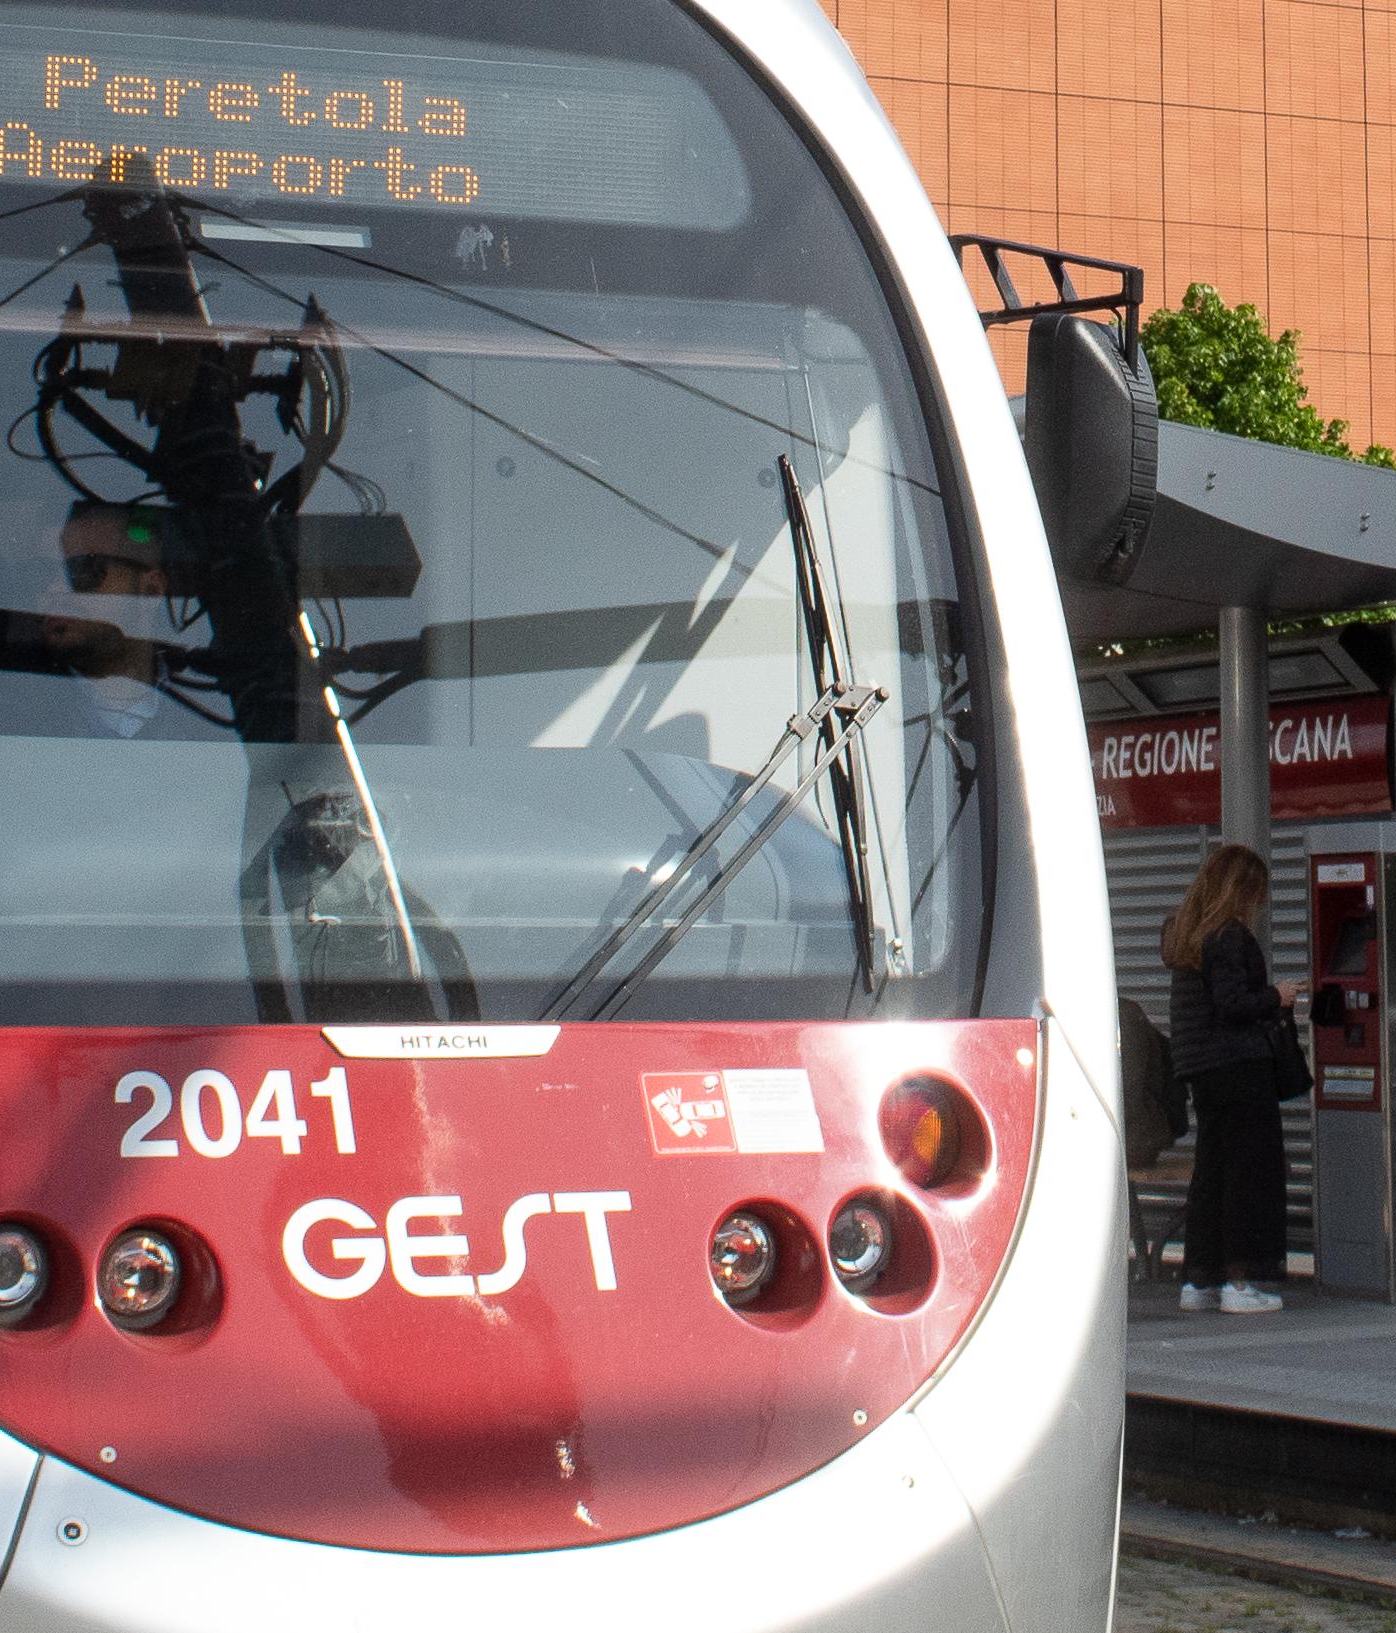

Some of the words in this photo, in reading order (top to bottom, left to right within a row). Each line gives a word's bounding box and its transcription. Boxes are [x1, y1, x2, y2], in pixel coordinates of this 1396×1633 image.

[44, 54, 467, 137] Peretola
[1101, 726, 1218, 779] REGIONE
[1269, 713, 1353, 765] CANA
[400, 1035, 488, 1049] HITACHI
[114, 1066, 357, 1158] 2041
[282, 1190, 632, 1300] GEST
